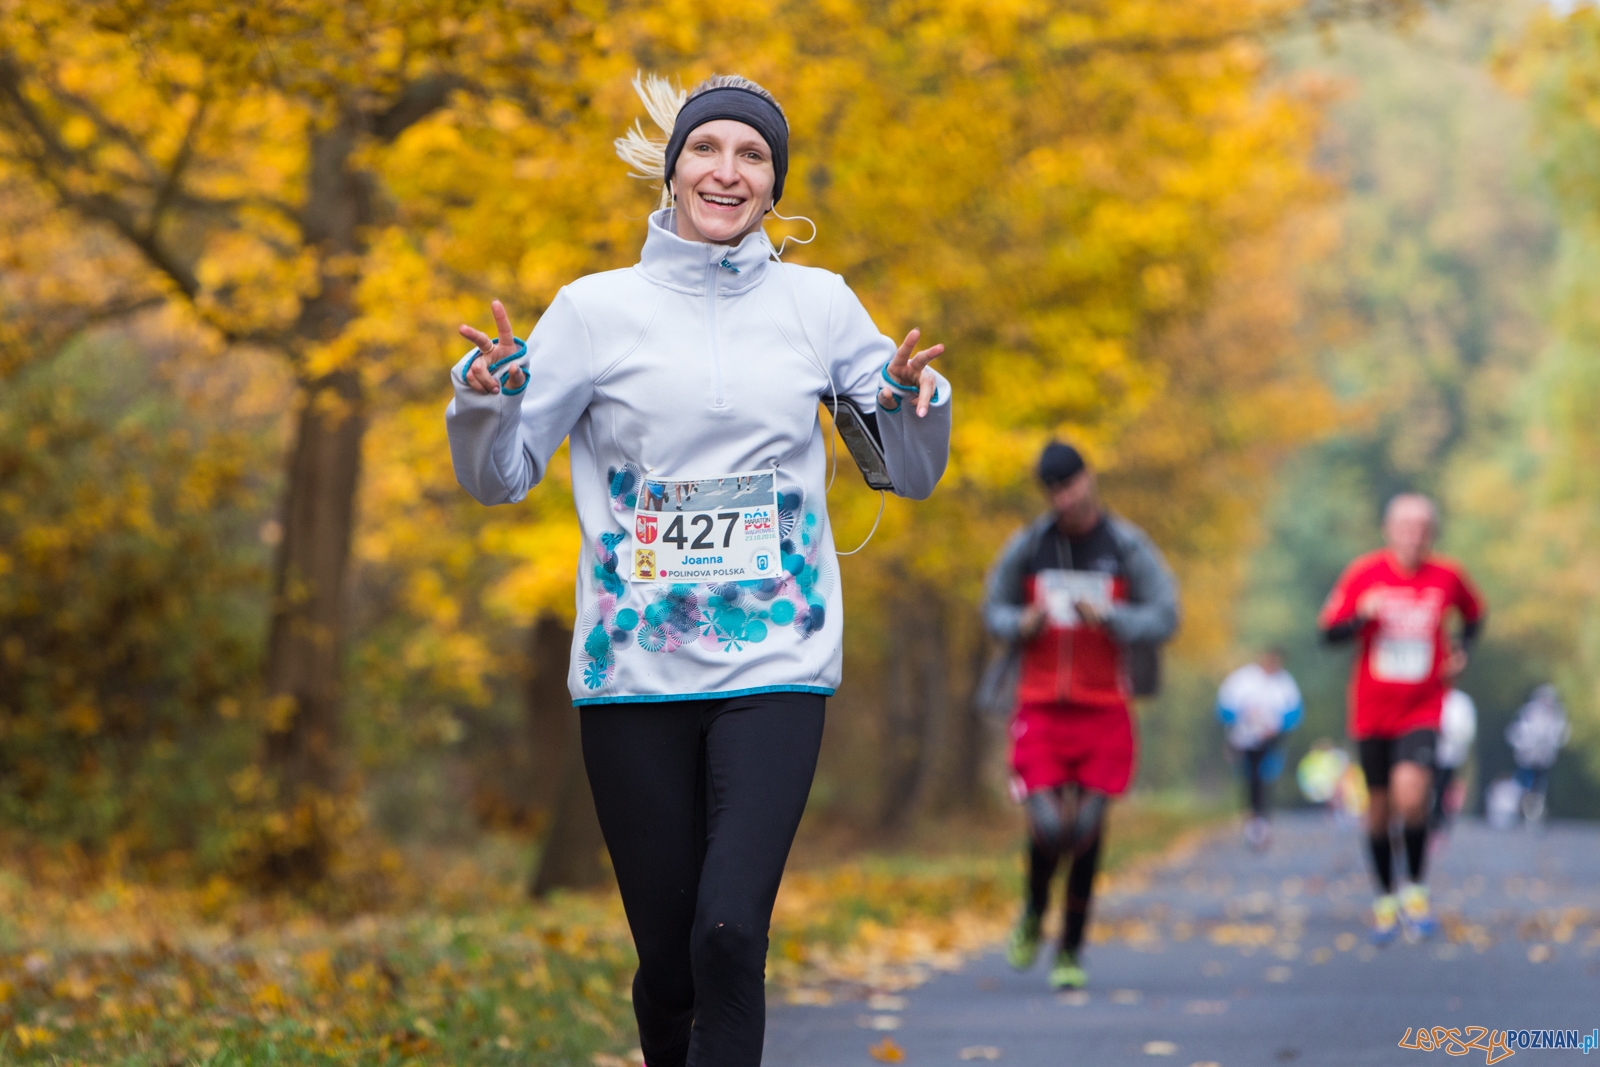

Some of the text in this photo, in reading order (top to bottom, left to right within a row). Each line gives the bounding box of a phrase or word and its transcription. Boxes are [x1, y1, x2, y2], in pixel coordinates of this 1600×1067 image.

[744, 517, 770, 525] MARATON
[662, 512, 740, 549] 427
[745, 533, 776, 541] 23.10.2016
[682, 556, 723, 565] Joanna
[713, 568, 745, 576] POLSKA
